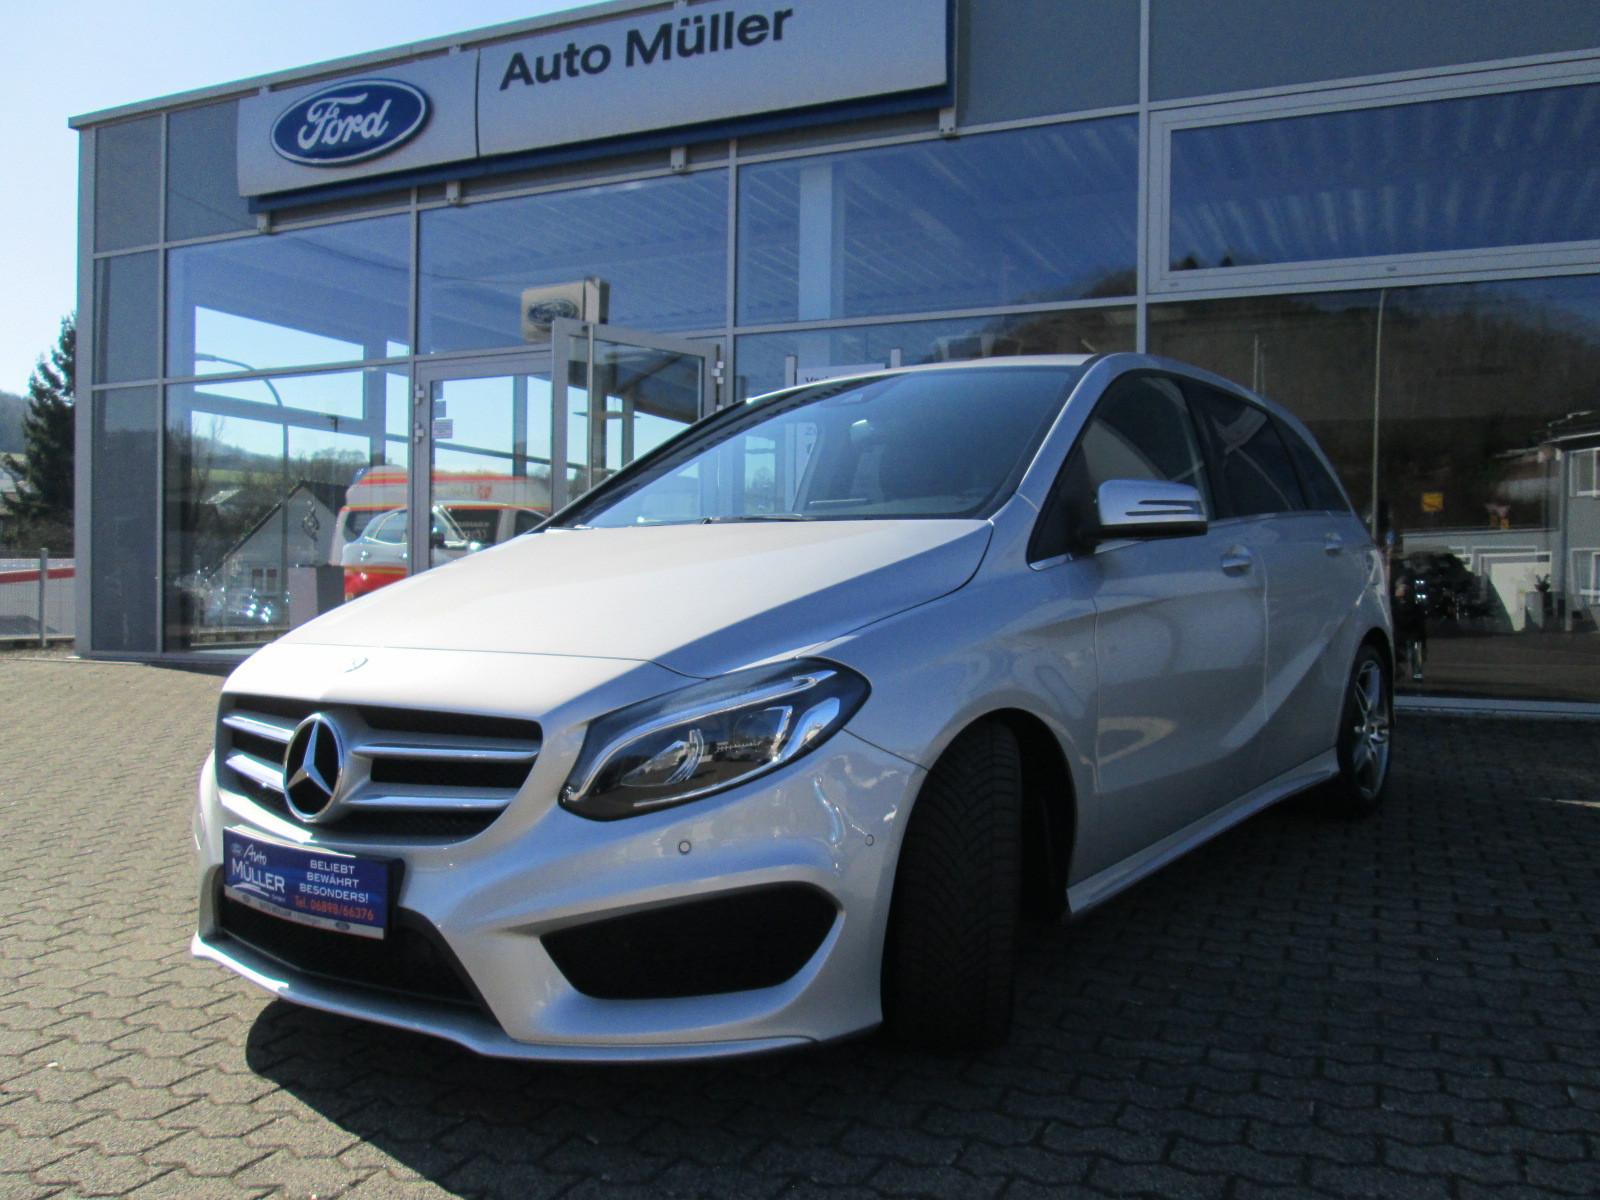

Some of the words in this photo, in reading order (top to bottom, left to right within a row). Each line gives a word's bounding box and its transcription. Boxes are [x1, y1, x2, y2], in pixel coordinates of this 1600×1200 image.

[499, 43, 612, 91] Auto
[625, 8, 793, 67] Müller
[297, 92, 393, 150] Ford
[231, 857, 286, 894] MÜLLER
[309, 859, 356, 875] BELIEBT
[299, 883, 370, 905] BESONDERS!
